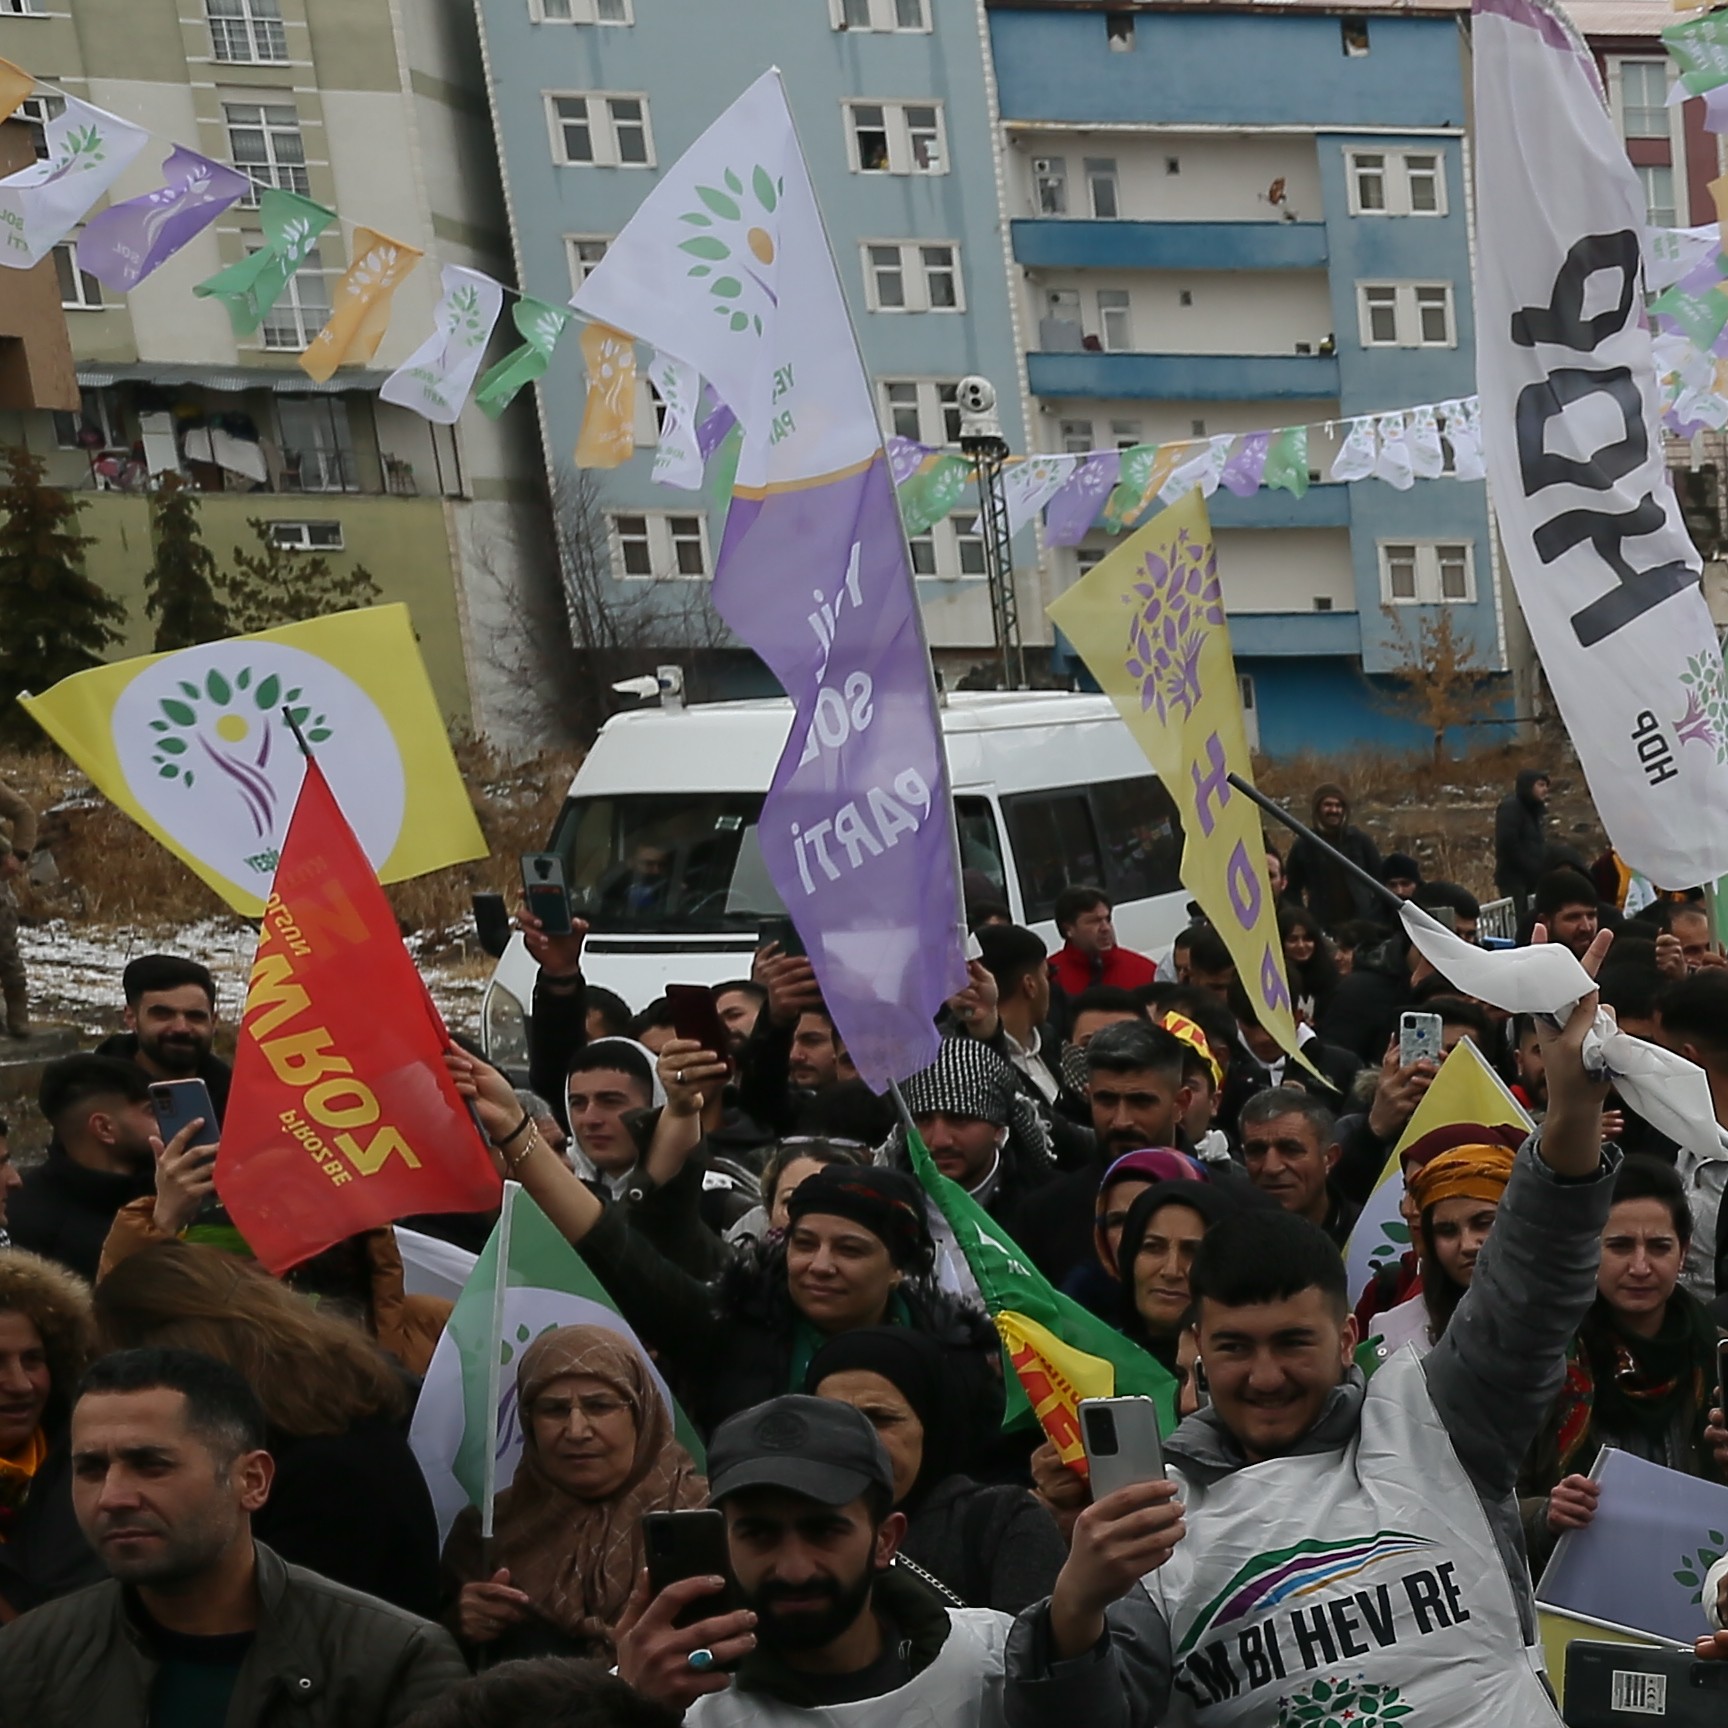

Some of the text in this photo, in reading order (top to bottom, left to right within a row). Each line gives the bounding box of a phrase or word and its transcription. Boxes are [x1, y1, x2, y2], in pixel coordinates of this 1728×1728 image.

[1238, 1619, 1286, 1689] BI
[1291, 1585, 1396, 1670] HEV
[1402, 1562, 1470, 1635] RE
